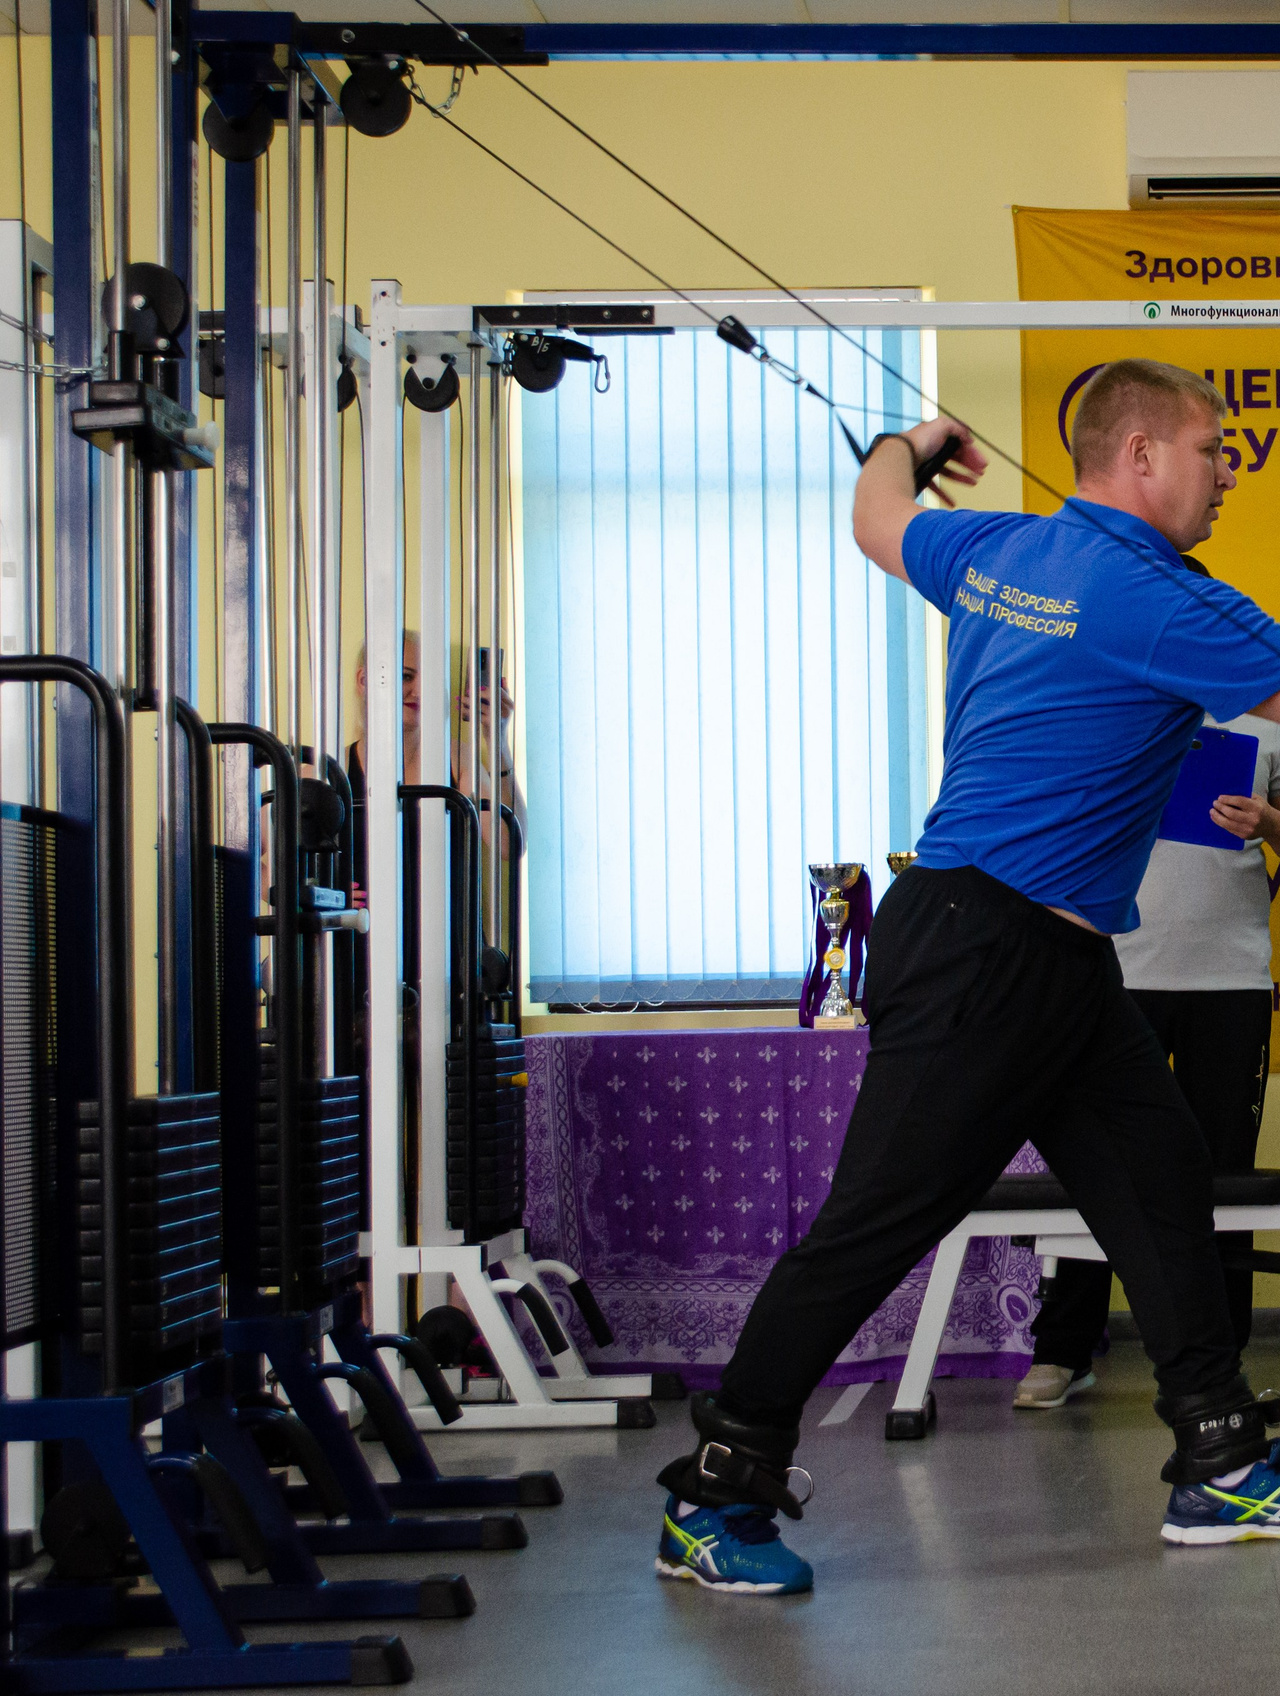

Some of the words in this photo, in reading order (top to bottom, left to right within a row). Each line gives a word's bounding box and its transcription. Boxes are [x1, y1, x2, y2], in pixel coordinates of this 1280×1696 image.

[965, 567, 998, 595] ВАШЕ
[956, 587, 985, 615] НАША
[988, 602, 1078, 639] ПРОФЕССИЯ
